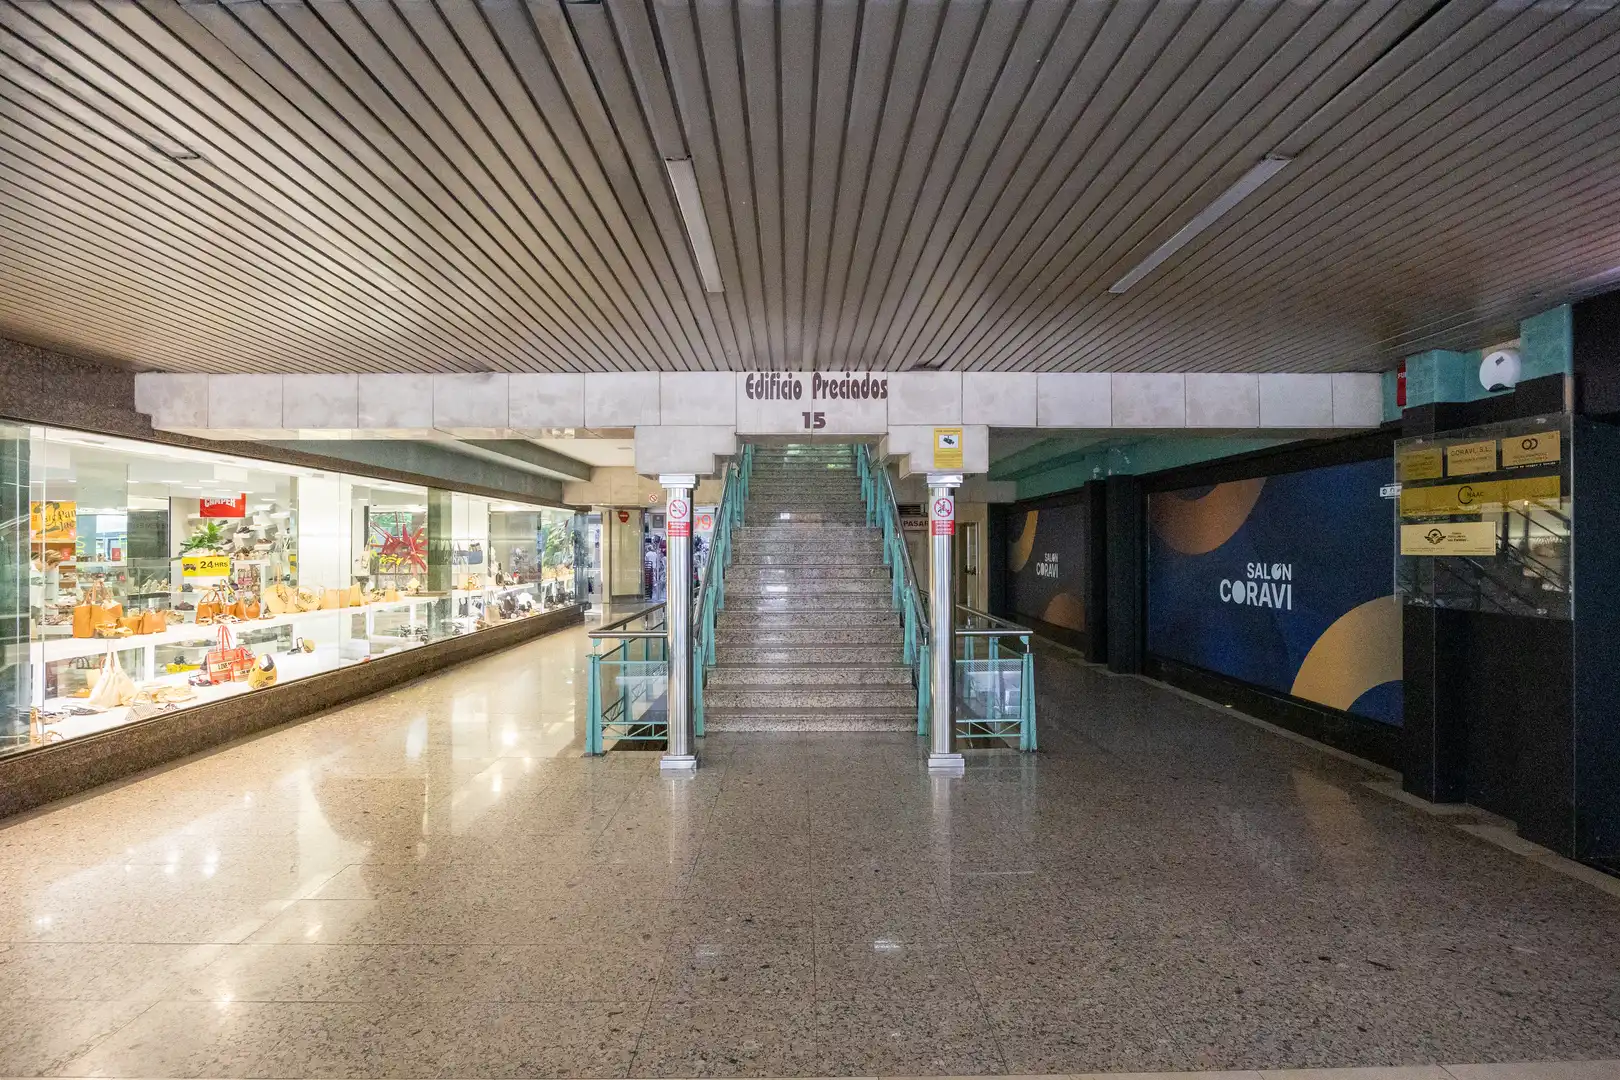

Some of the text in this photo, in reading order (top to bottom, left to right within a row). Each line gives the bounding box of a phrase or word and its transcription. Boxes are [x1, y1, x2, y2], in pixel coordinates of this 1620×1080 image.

[745, 371, 888, 400] Edificio Preciados
[802, 411, 826, 429] 15
[200, 561, 214, 569] 24
[1036, 562, 1059, 578] CORAVI
[1220, 579, 1292, 610] CORAVI
